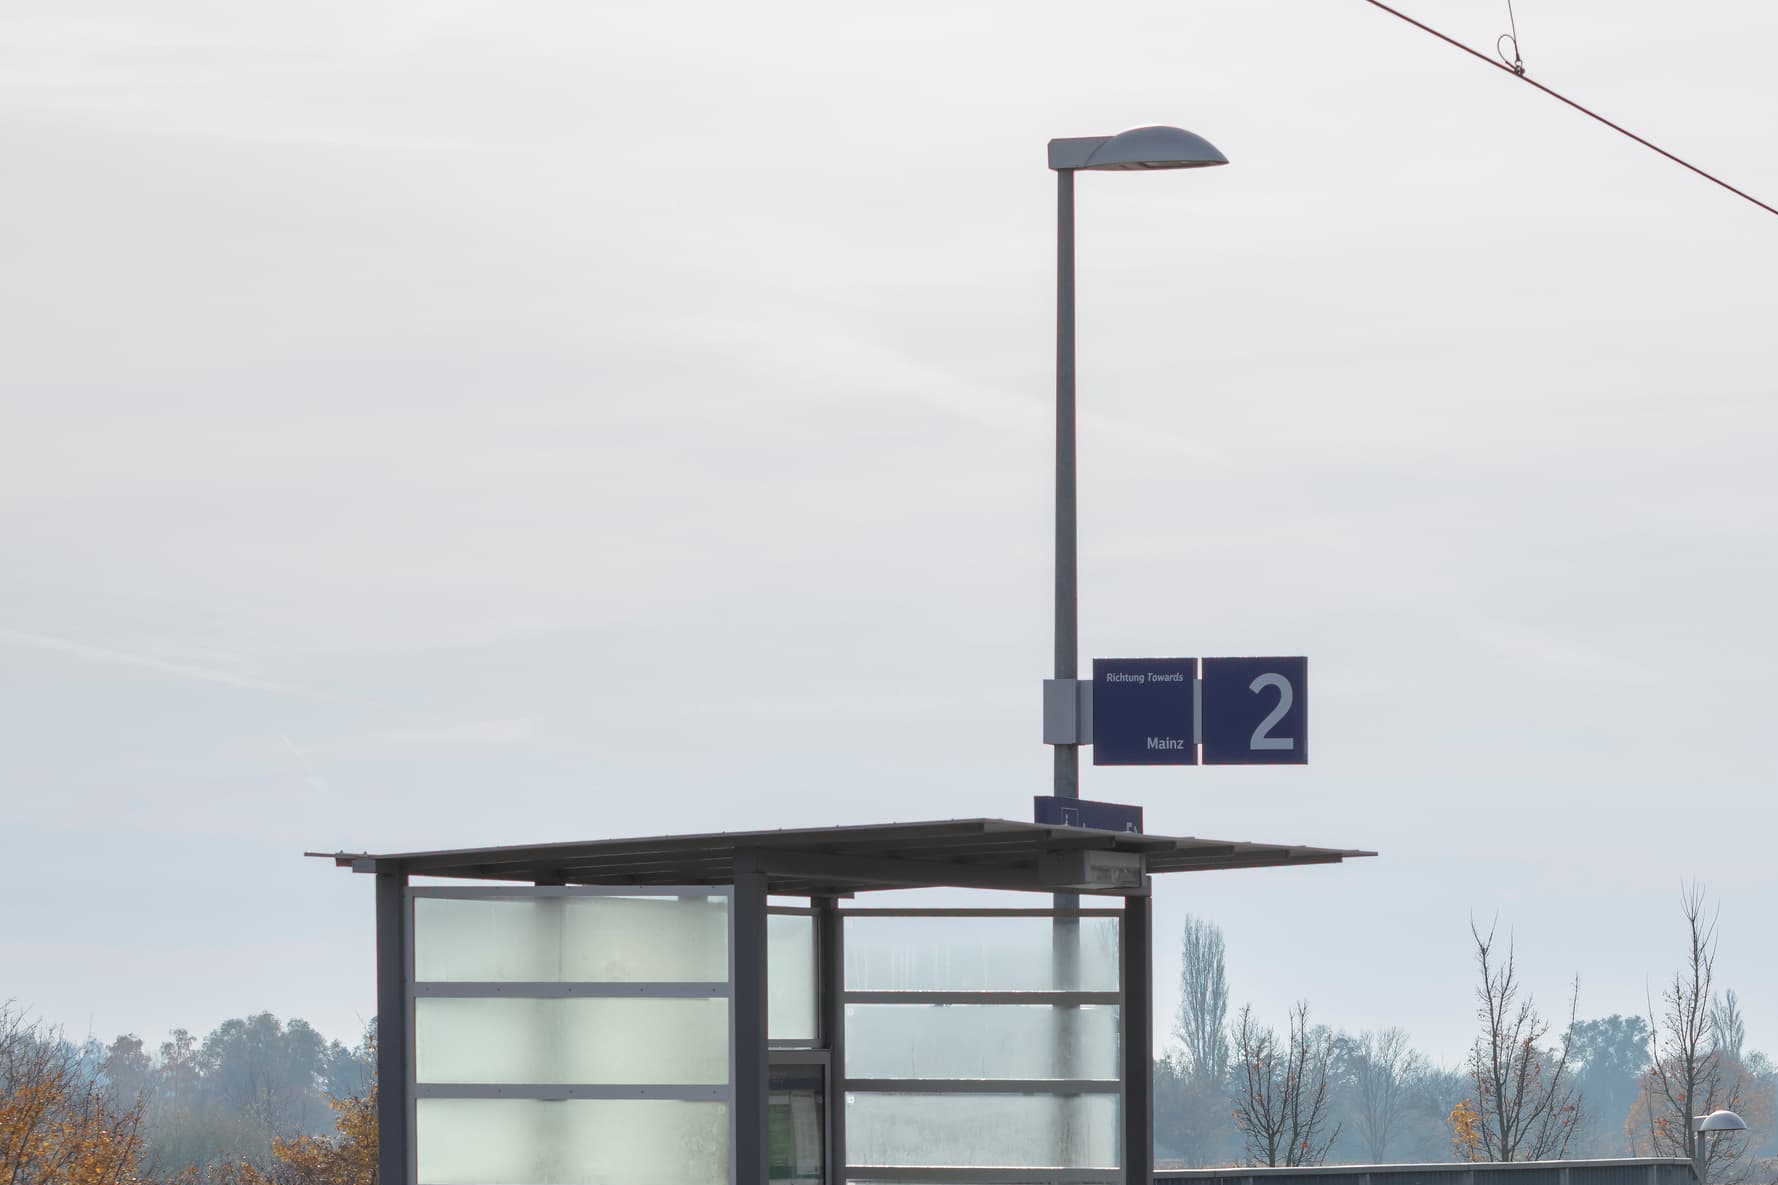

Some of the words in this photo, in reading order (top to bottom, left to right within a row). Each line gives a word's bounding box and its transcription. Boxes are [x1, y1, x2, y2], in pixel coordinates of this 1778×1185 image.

[1106, 673, 1144, 684] Richtung
[1147, 673, 1184, 682] Towards
[1249, 672, 1294, 750] 2
[1147, 737, 1184, 750] Mainz
